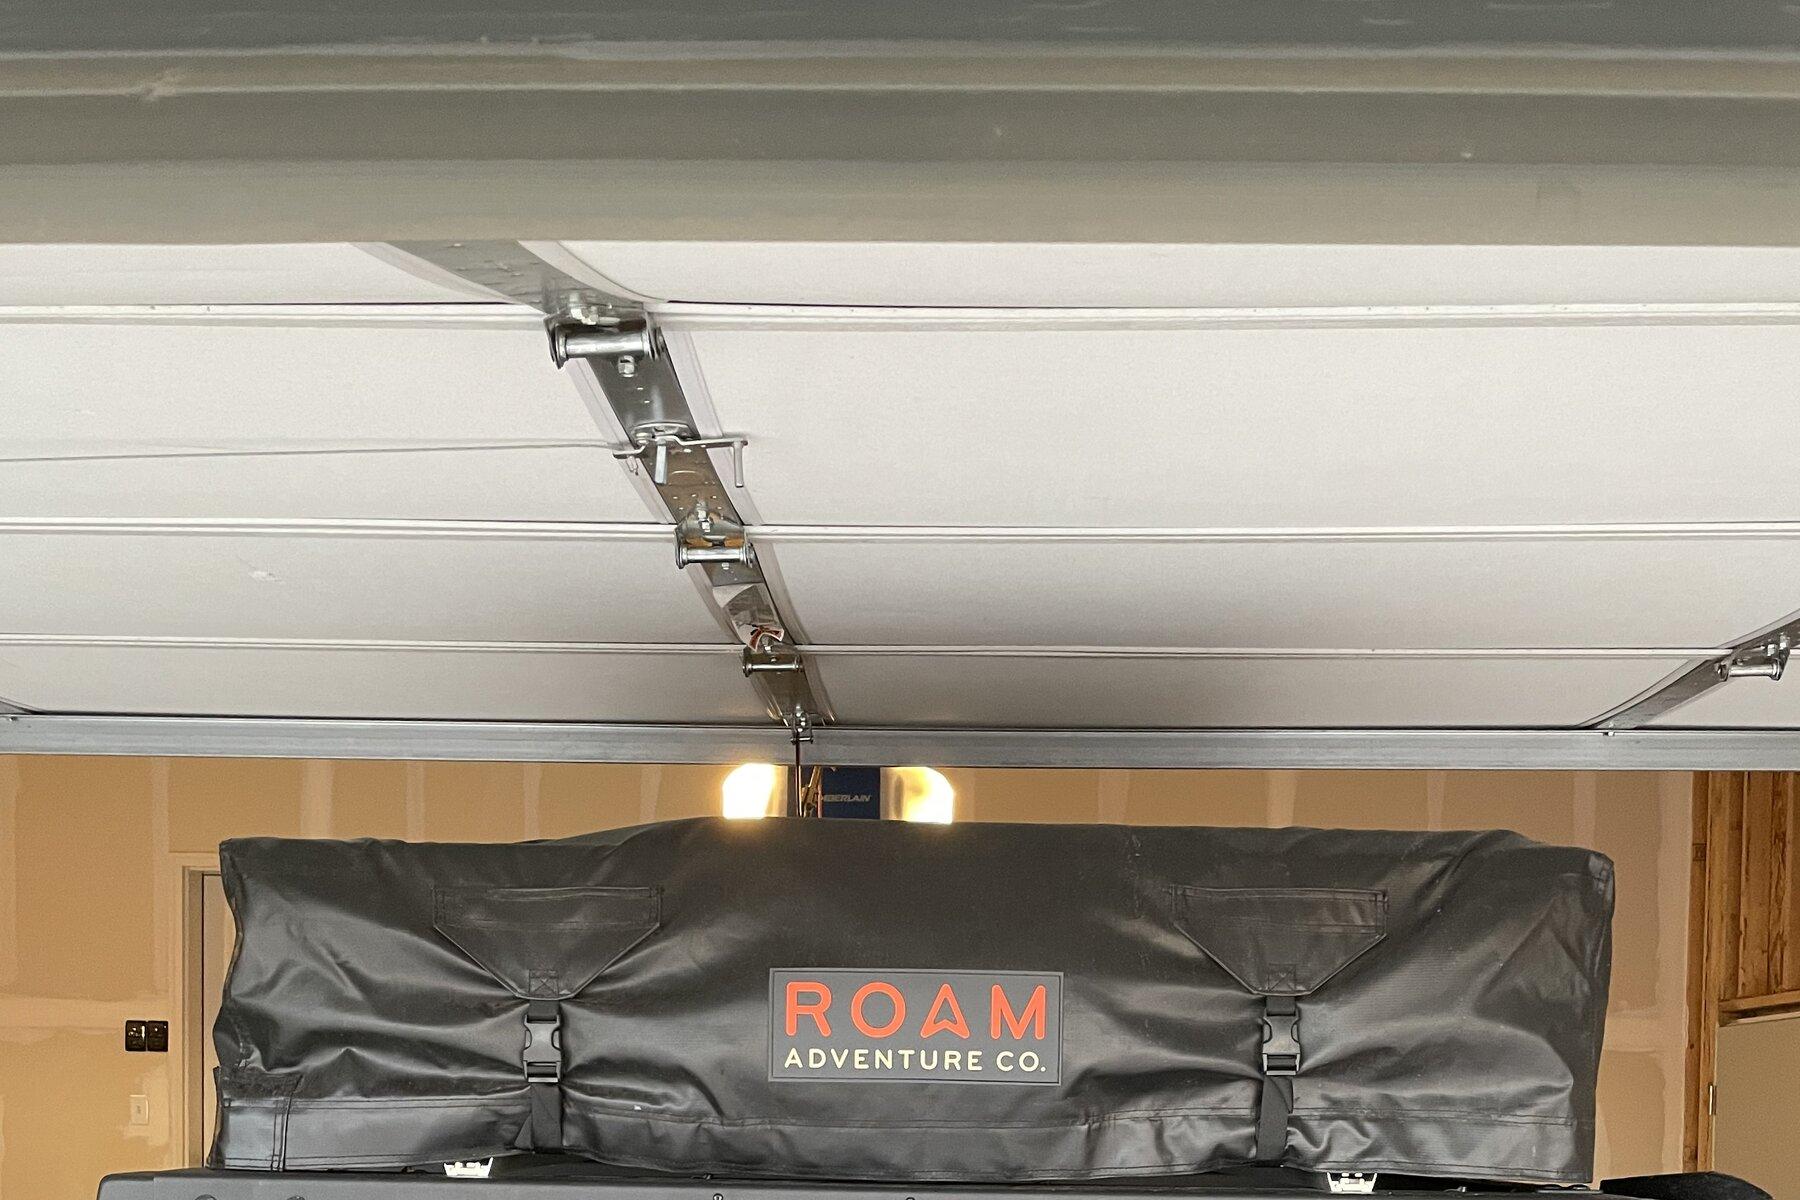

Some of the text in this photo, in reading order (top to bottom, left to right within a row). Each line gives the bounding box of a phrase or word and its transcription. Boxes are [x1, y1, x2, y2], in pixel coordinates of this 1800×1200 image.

[785, 981, 1047, 1040] ROAM
[784, 1047, 1047, 1072] ADVENTURE CO.
